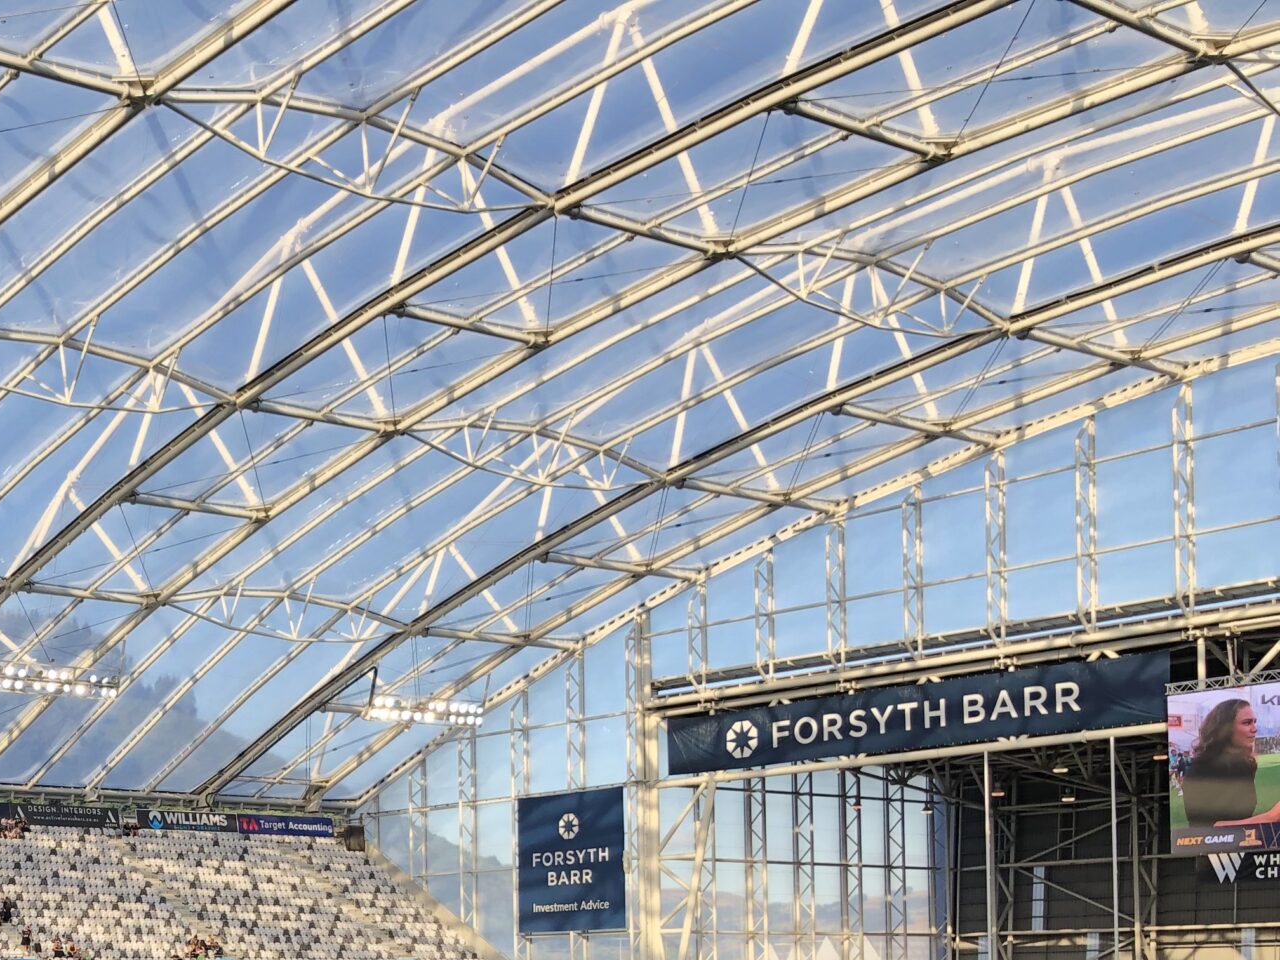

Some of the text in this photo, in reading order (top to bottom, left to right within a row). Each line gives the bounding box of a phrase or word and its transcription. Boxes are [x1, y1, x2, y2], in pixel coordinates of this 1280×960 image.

[772, 681, 1081, 748] FORSYTH BARR
[163, 811, 228, 826] WILLIAMS
[259, 820, 286, 831] Target
[288, 822, 333, 834] Accounting
[1176, 834, 1235, 846] NEXT GAME
[532, 847, 609, 867] FORSYTH
[547, 868, 593, 886] BARR
[533, 899, 610, 913] Investment Advice
